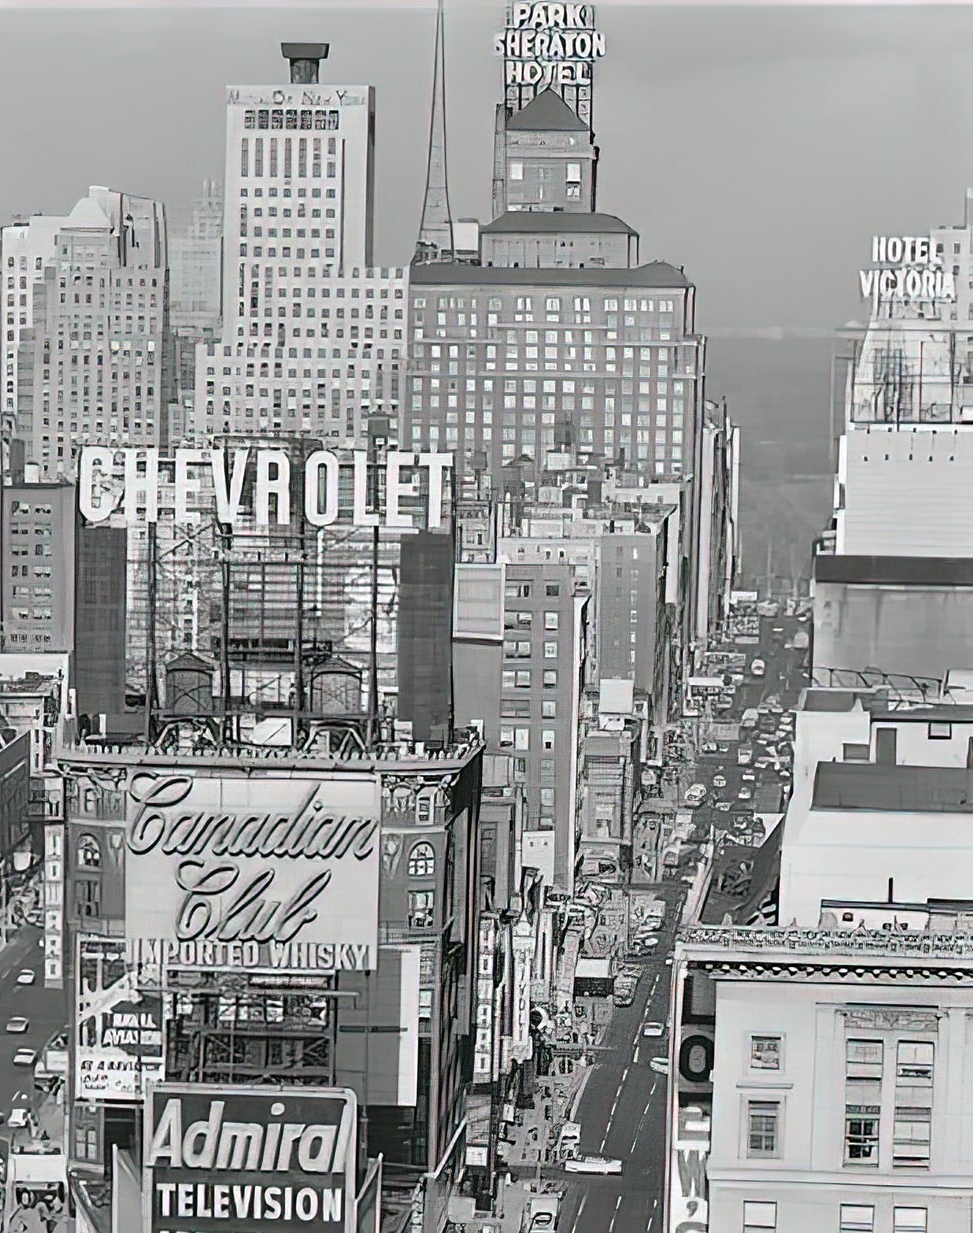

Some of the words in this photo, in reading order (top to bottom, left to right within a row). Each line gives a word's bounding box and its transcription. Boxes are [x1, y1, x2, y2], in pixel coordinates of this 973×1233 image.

[513, 3, 584, 28] PARK
[493, 30, 606, 58] SHERATON
[506, 61, 591, 85] HOTEL
[872, 236, 942, 265] HOTEL
[859, 268, 955, 300] VICTORIA
[79, 446, 454, 528] CHEVROLET
[126, 772, 377, 861] Canadian
[174, 861, 331, 943] Club
[132, 939, 259, 967] IMPORTED
[269, 943, 368, 970] WHISKY
[146, 1098, 352, 1173] Admiral
[156, 1183, 341, 1222] TELEVISION
